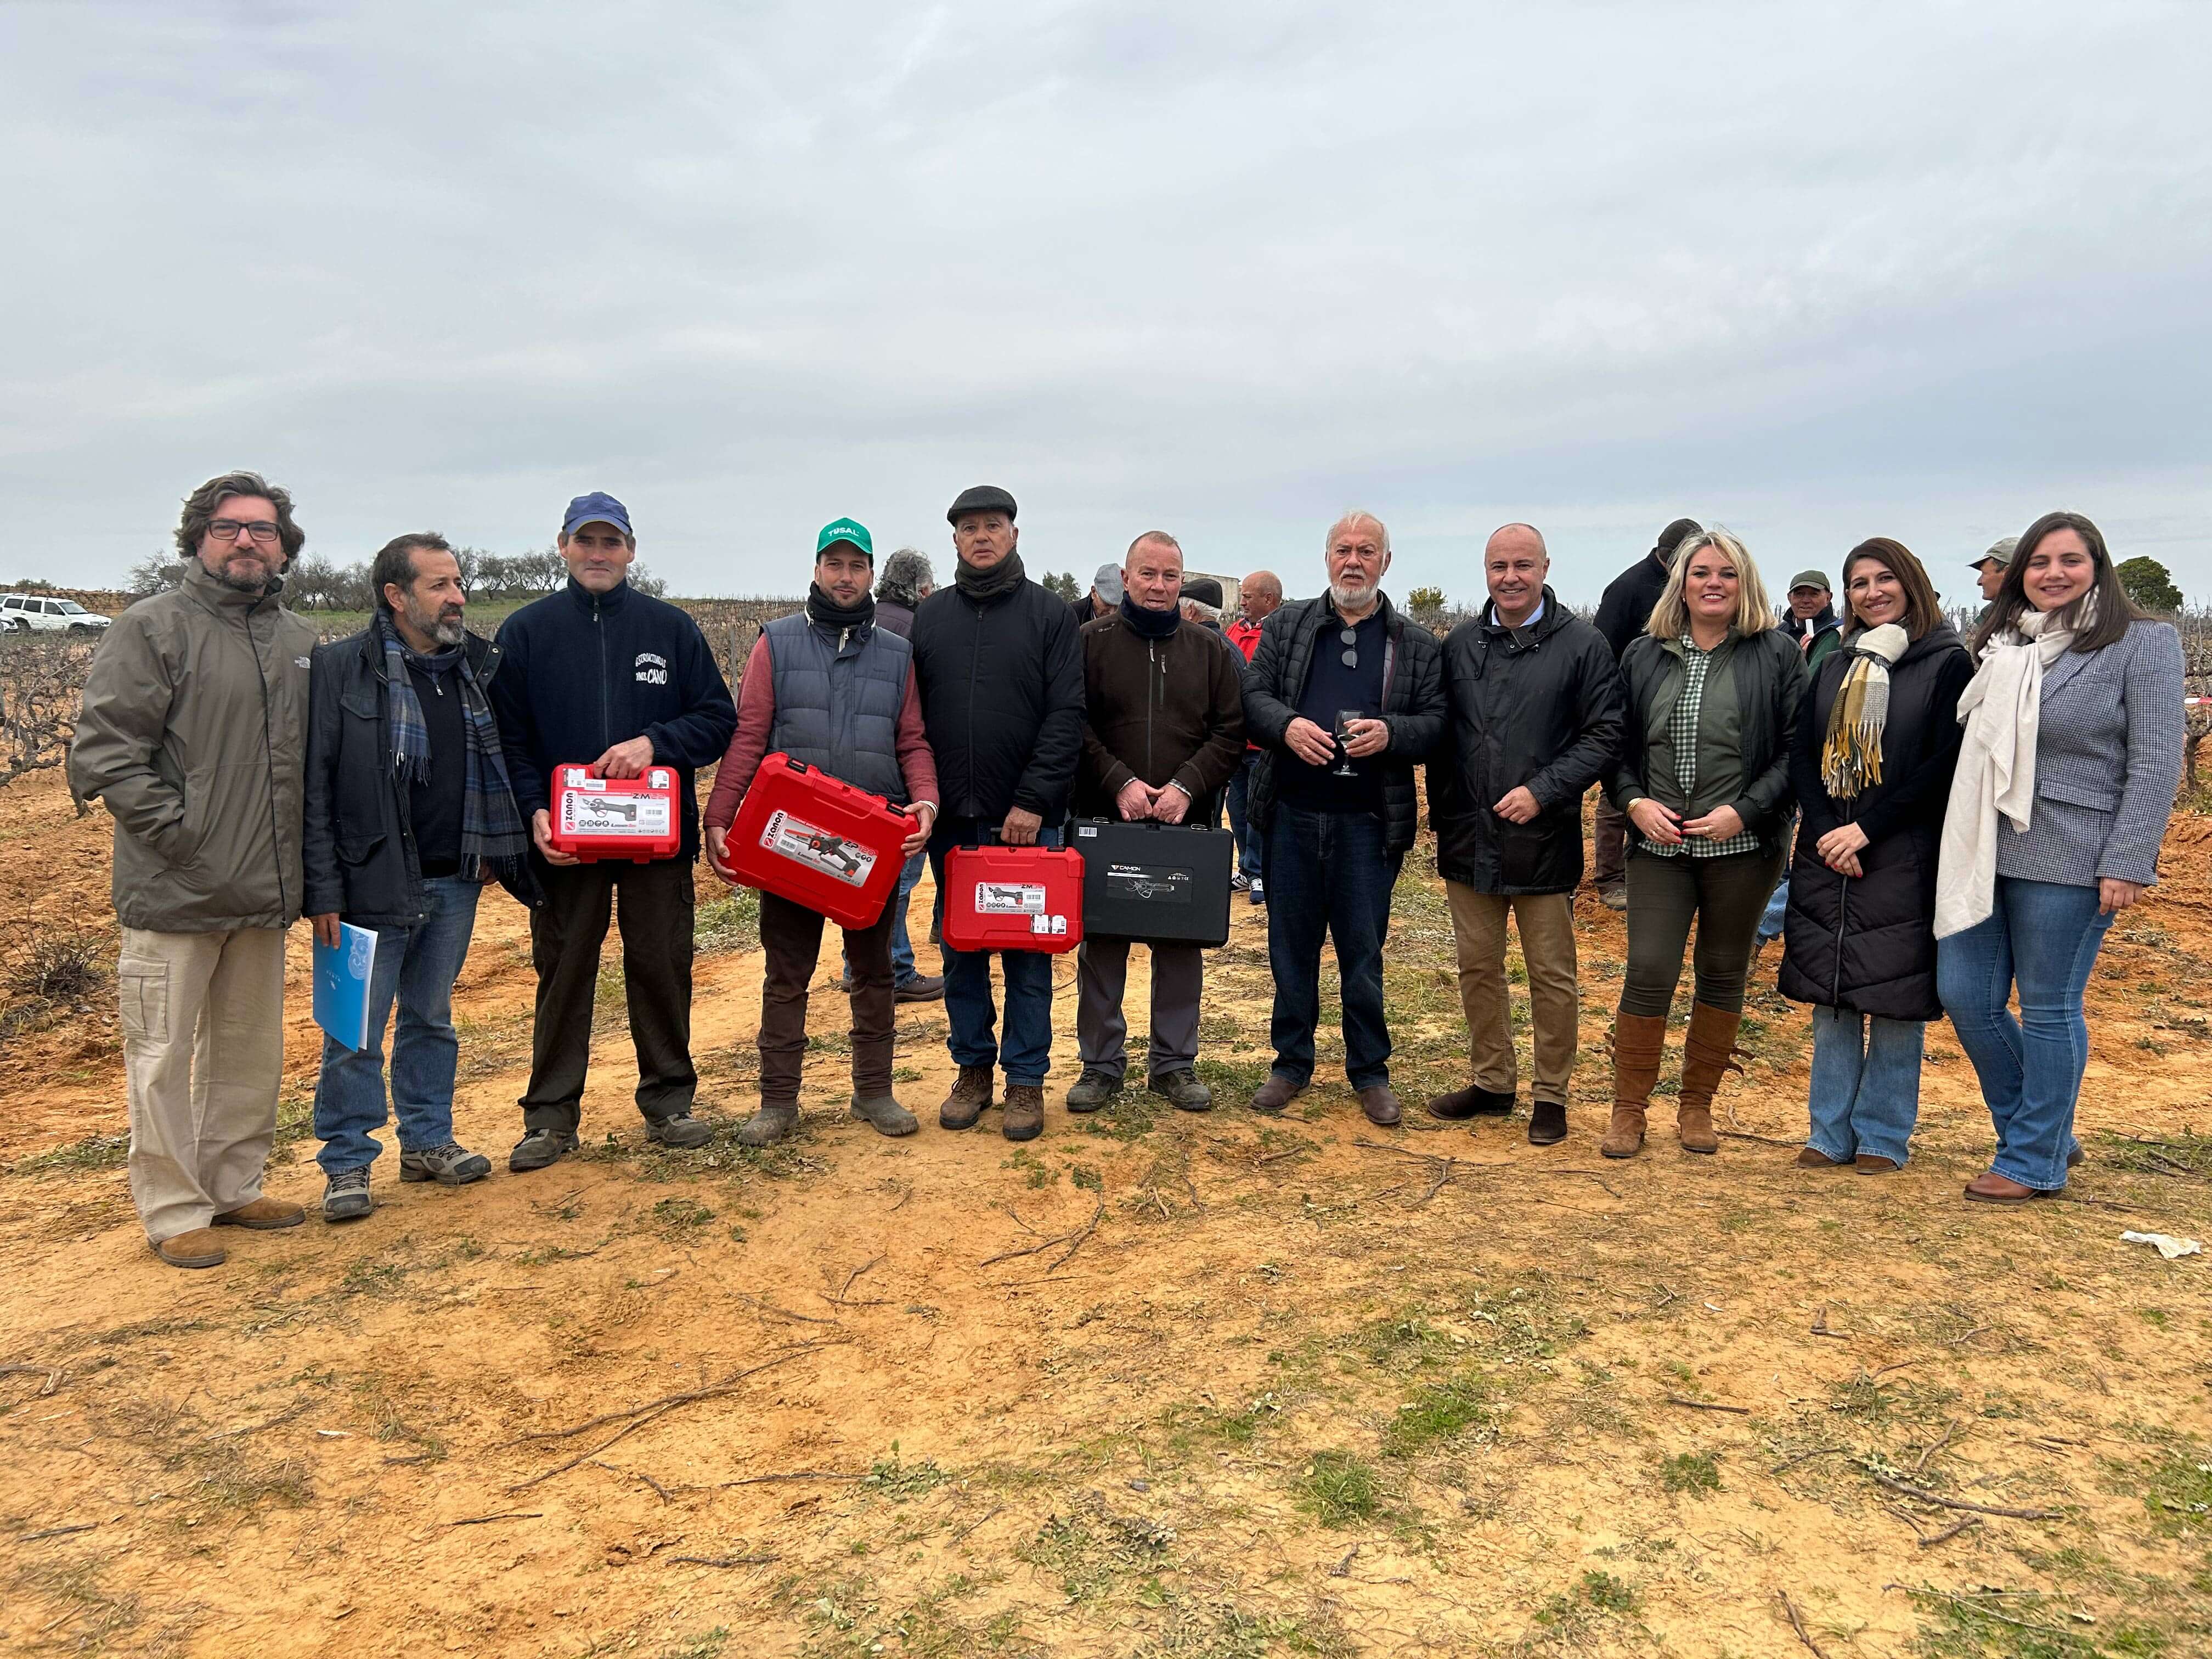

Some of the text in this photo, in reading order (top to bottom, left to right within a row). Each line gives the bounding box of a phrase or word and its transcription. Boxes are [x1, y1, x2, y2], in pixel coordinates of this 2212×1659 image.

[828, 527, 859, 537] TUSAL
[647, 668, 667, 685] CANO
[768, 812, 784, 838] zanon
